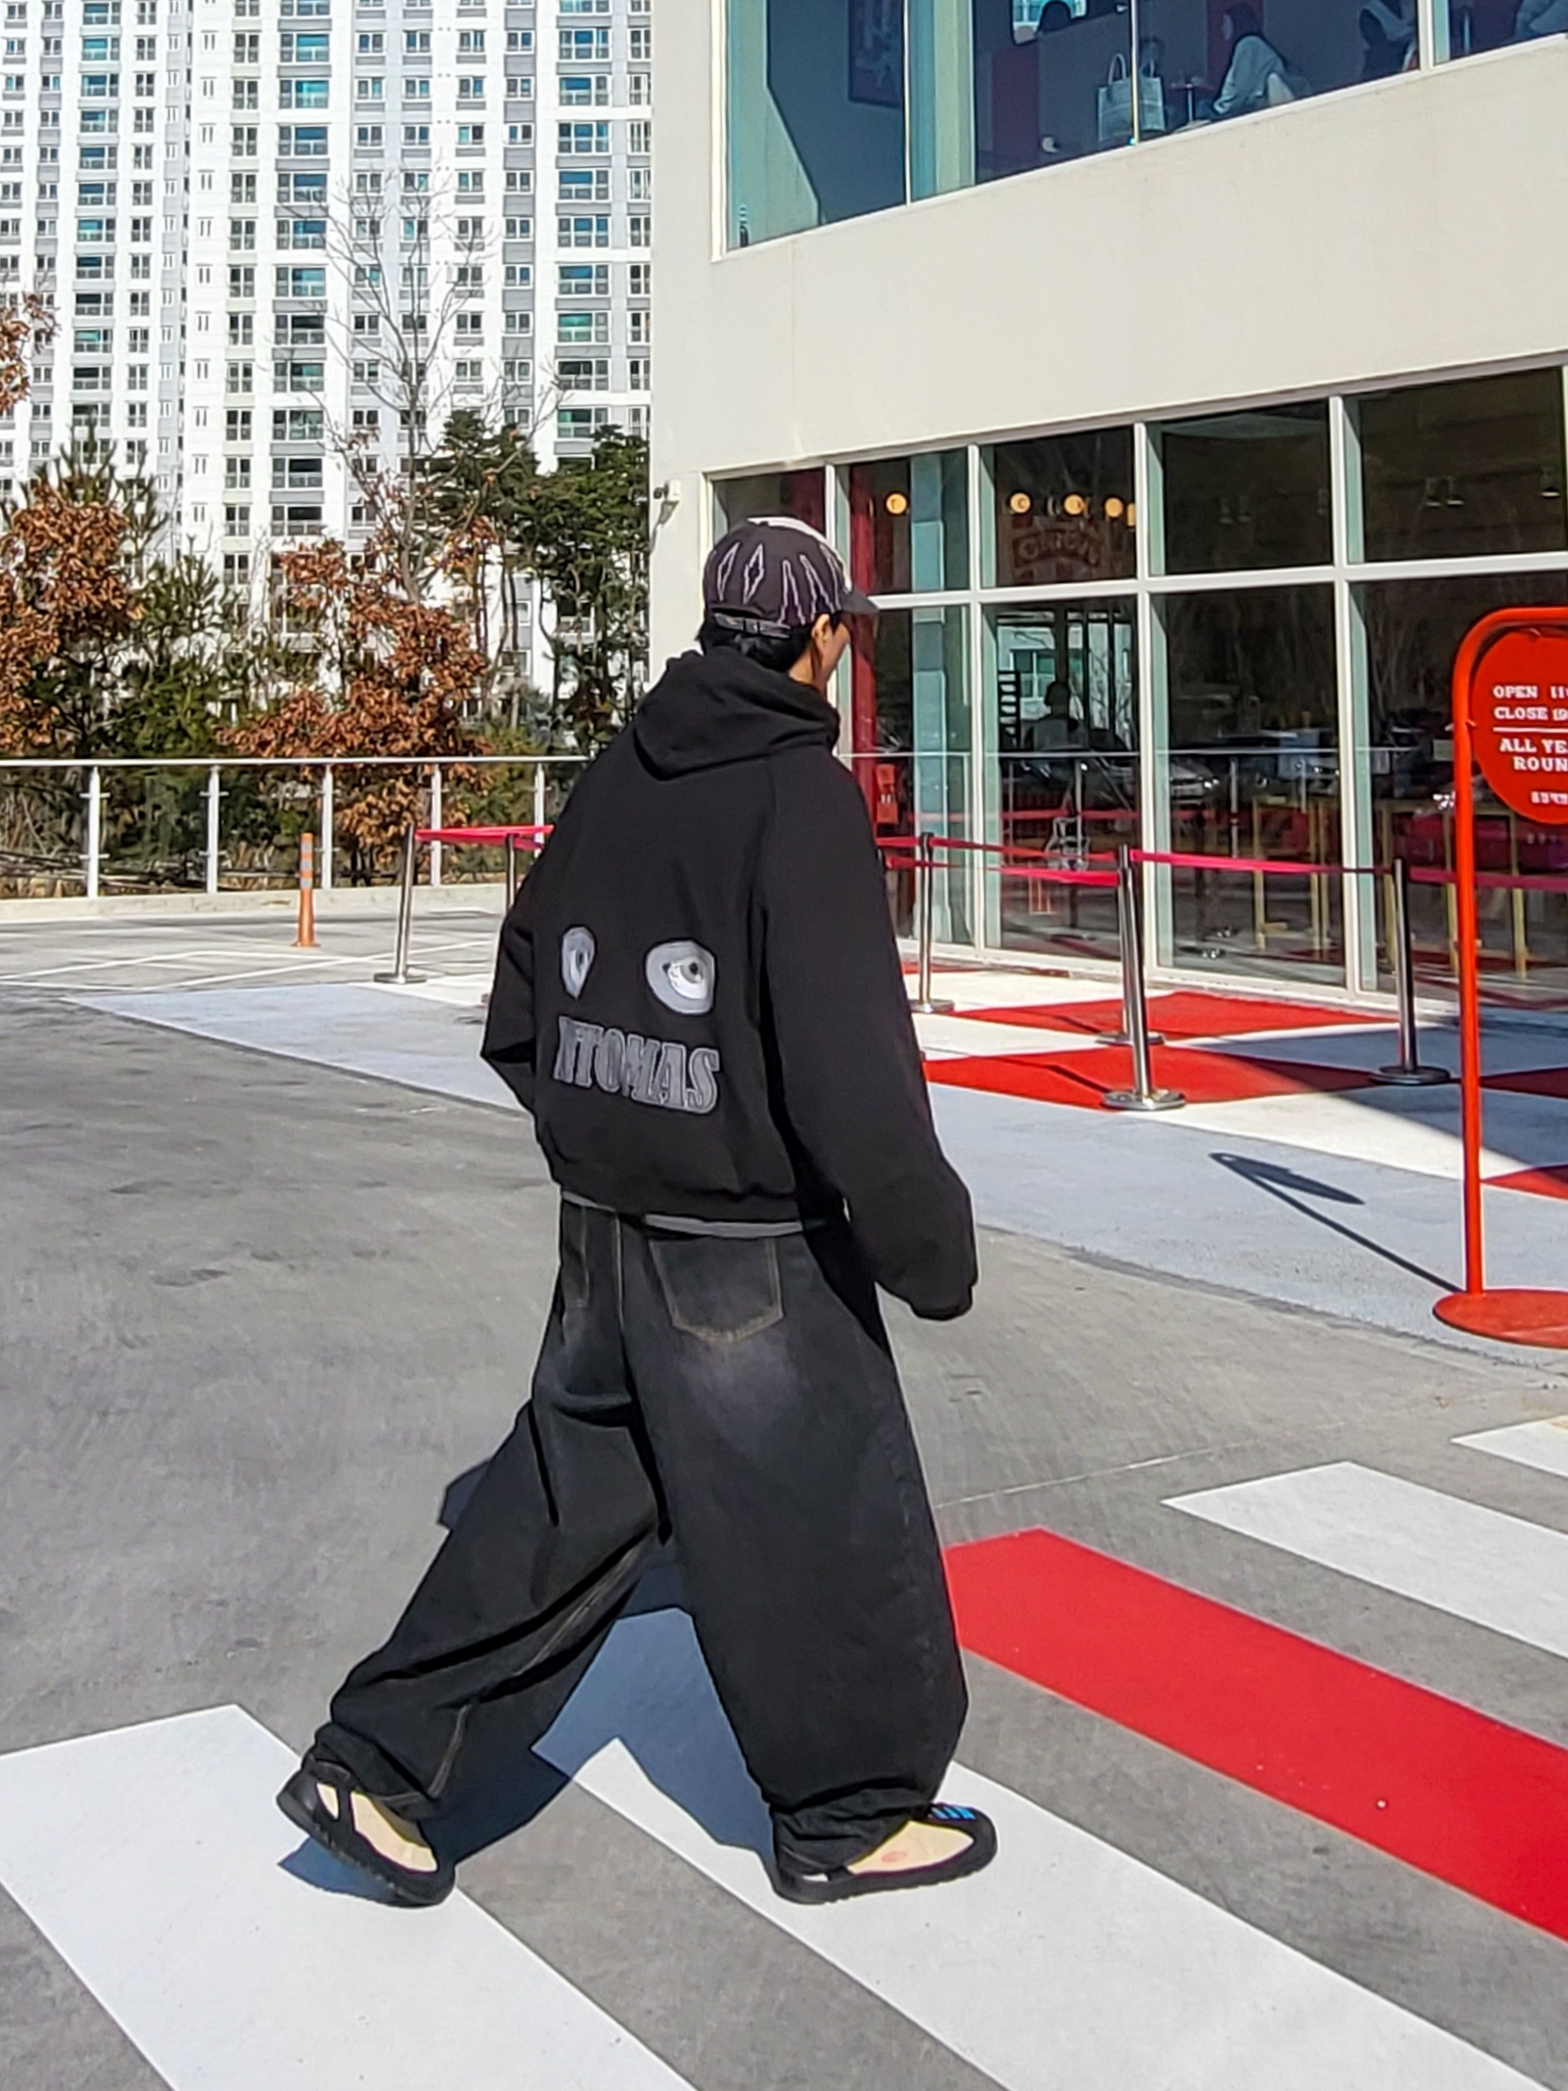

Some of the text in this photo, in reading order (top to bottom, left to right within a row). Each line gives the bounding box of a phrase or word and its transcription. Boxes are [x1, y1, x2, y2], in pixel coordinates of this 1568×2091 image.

[1493, 685, 1568, 700] OPEN 11
[1494, 706, 1549, 721] CLOSE
[1500, 738, 1568, 754] ALL YE
